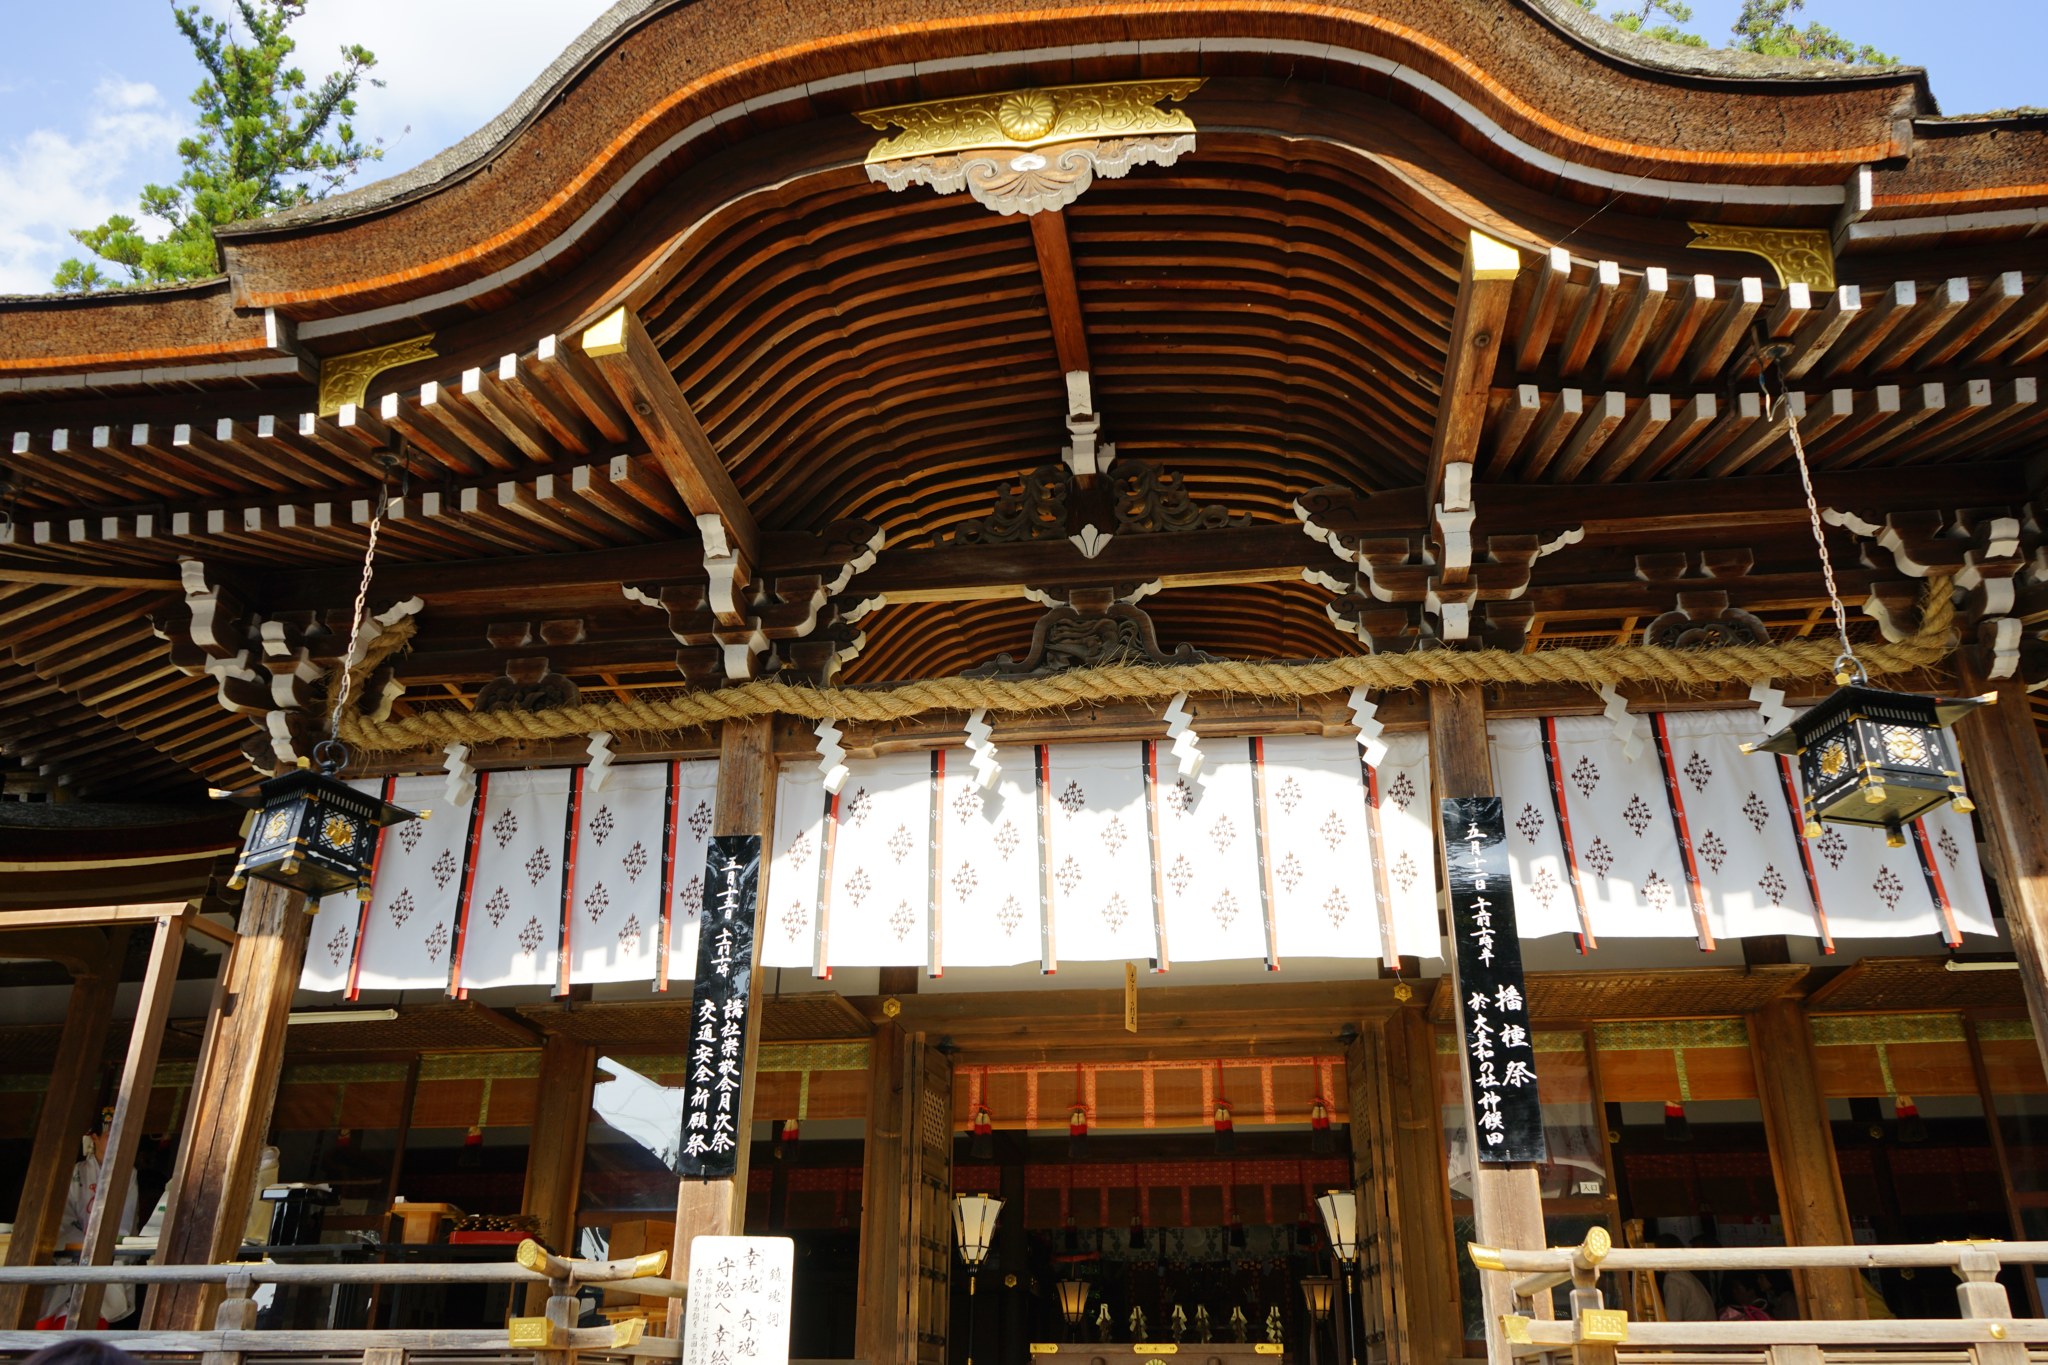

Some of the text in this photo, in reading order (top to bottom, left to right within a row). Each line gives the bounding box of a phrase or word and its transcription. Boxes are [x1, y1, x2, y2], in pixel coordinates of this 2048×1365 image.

[711, 856, 743, 979] 五月十五日 午前十時
[1464, 822, 1496, 969] 五月十二日 午前十時半
[683, 998, 718, 1158] 交通安全祈願祭
[708, 998, 745, 1155] 講社崇敬会月次祭
[1494, 984, 1538, 1088] 播種祭
[1583, 1184, 1598, 1192] 入口
[714, 1256, 736, 1314] 守給へ
[737, 1247, 761, 1357] 幸魂 奇魂
[767, 1266, 782, 1328] 鎮魂詞
